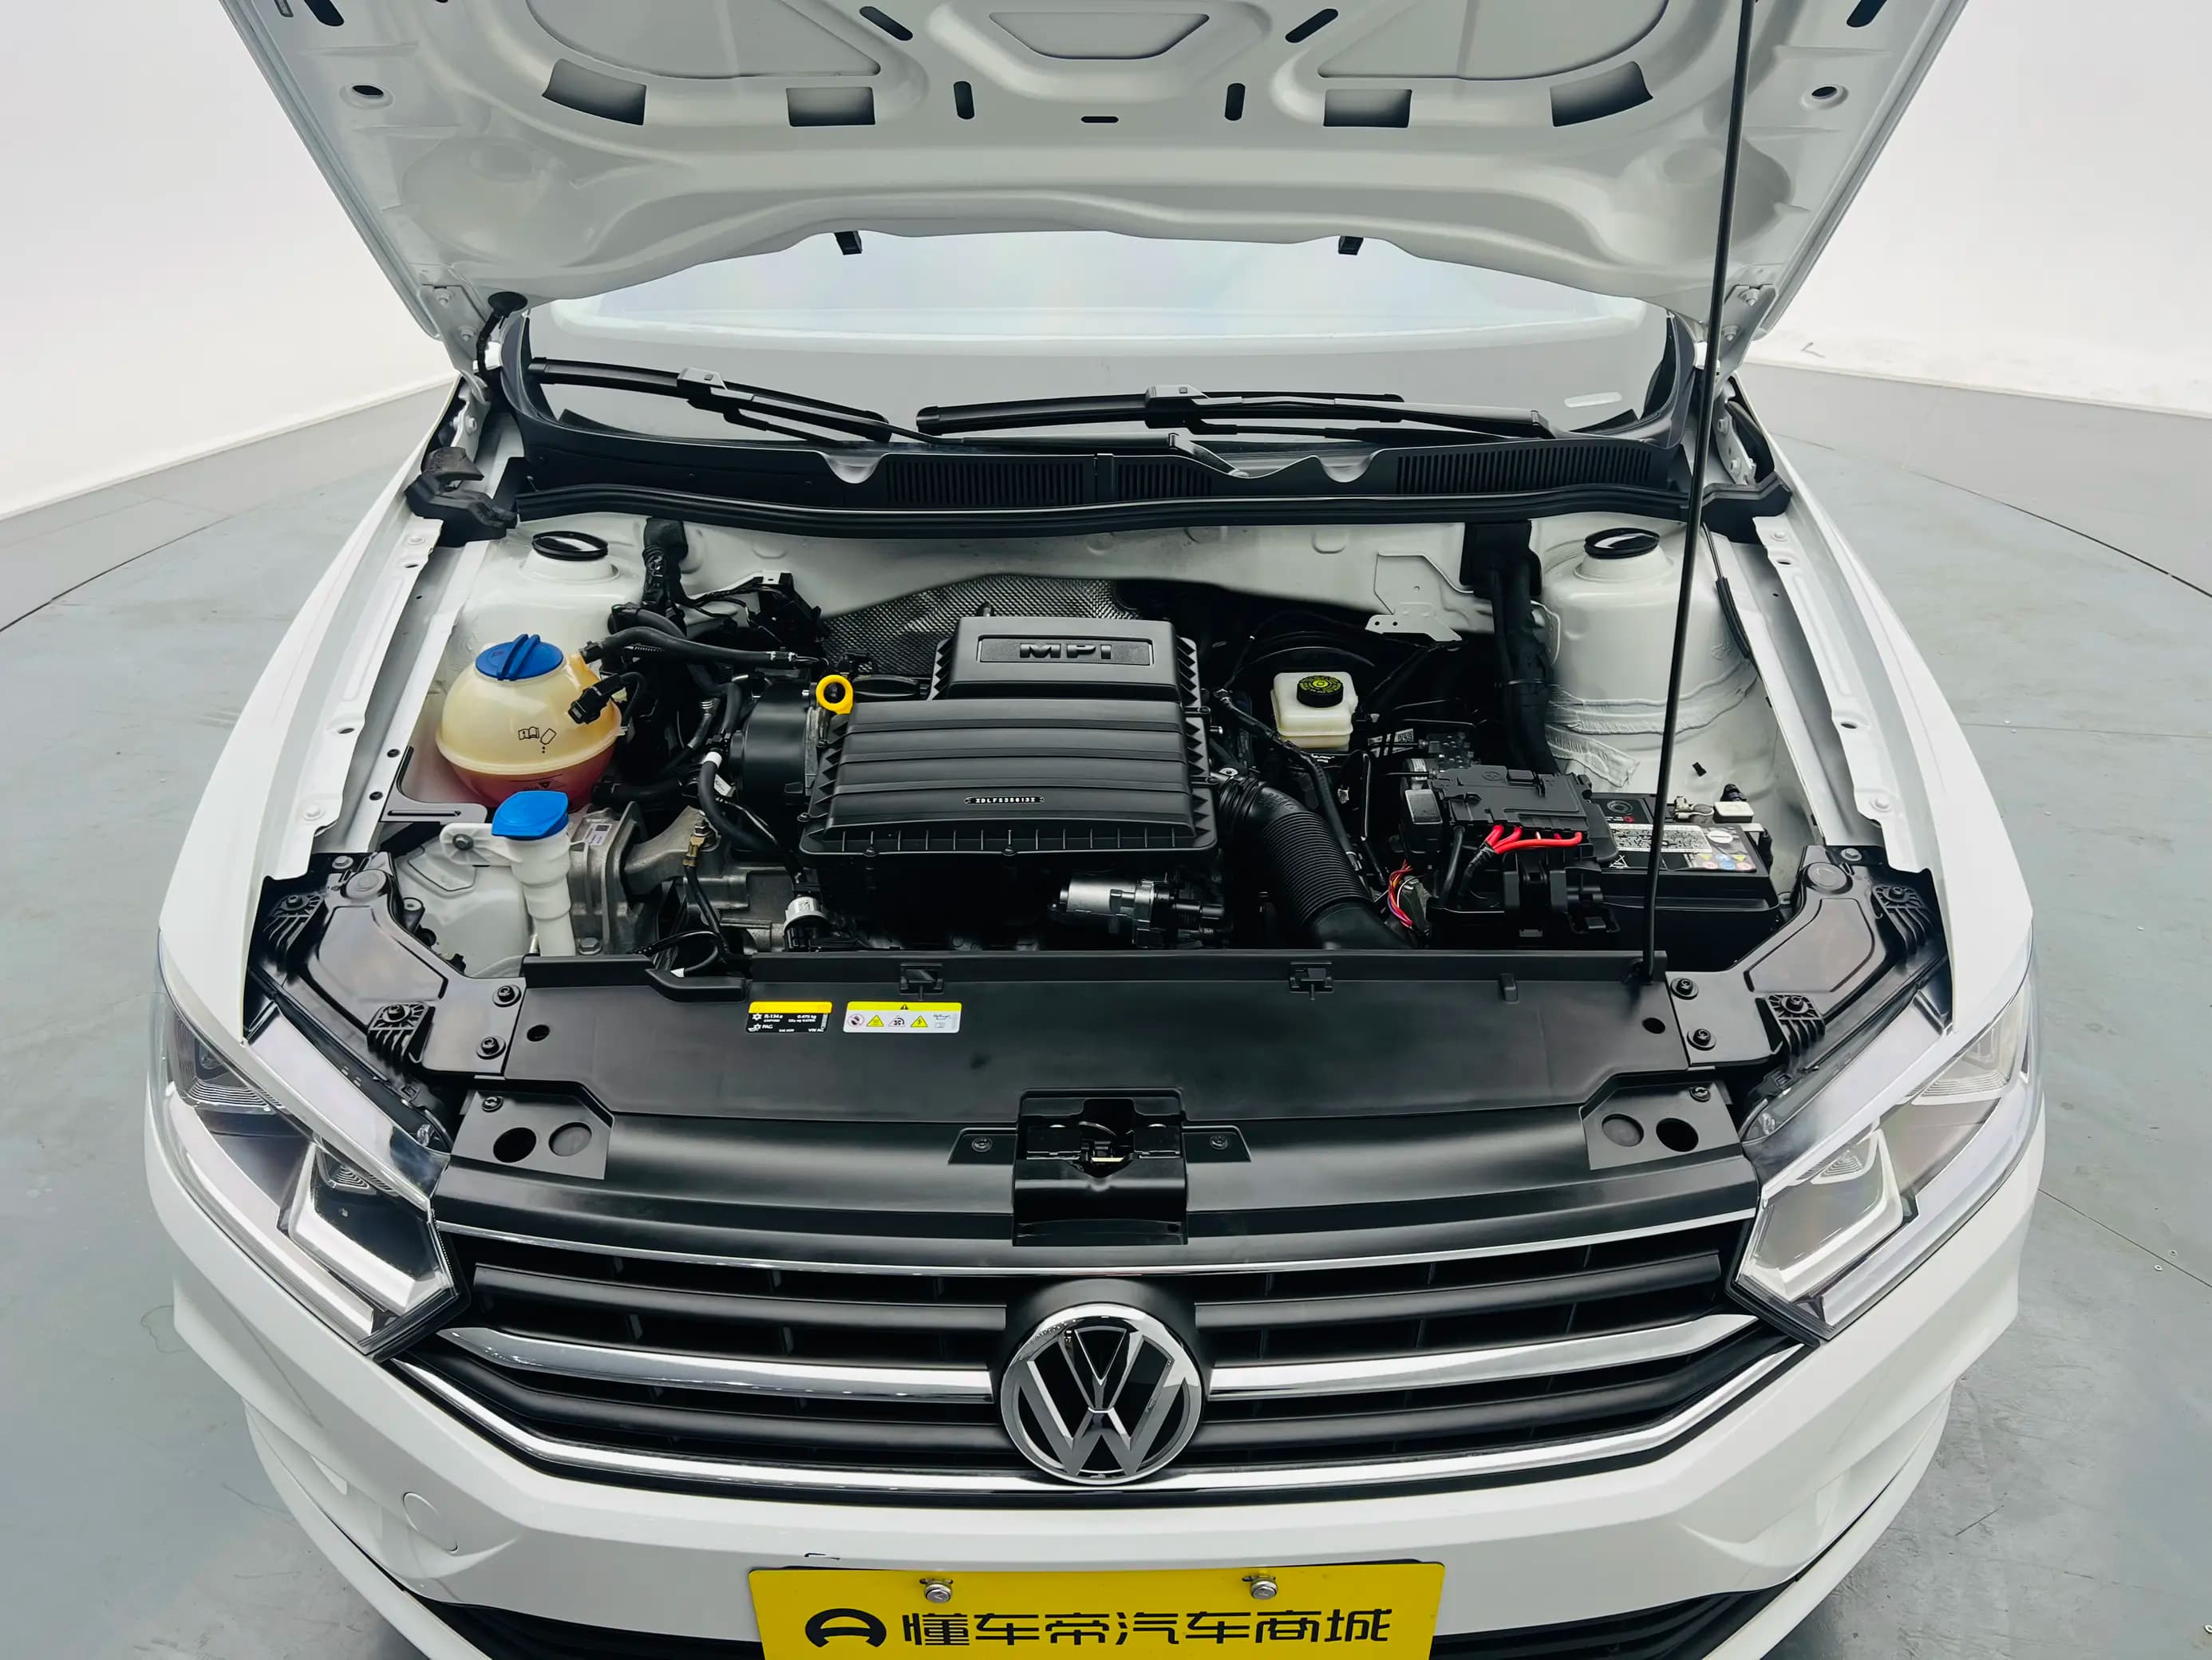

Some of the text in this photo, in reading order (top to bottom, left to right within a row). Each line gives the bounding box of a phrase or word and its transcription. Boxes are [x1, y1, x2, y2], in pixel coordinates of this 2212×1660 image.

[1019, 642, 1112, 660] MPI
[903, 1608, 1392, 1646] 懂车帝汽车商城
